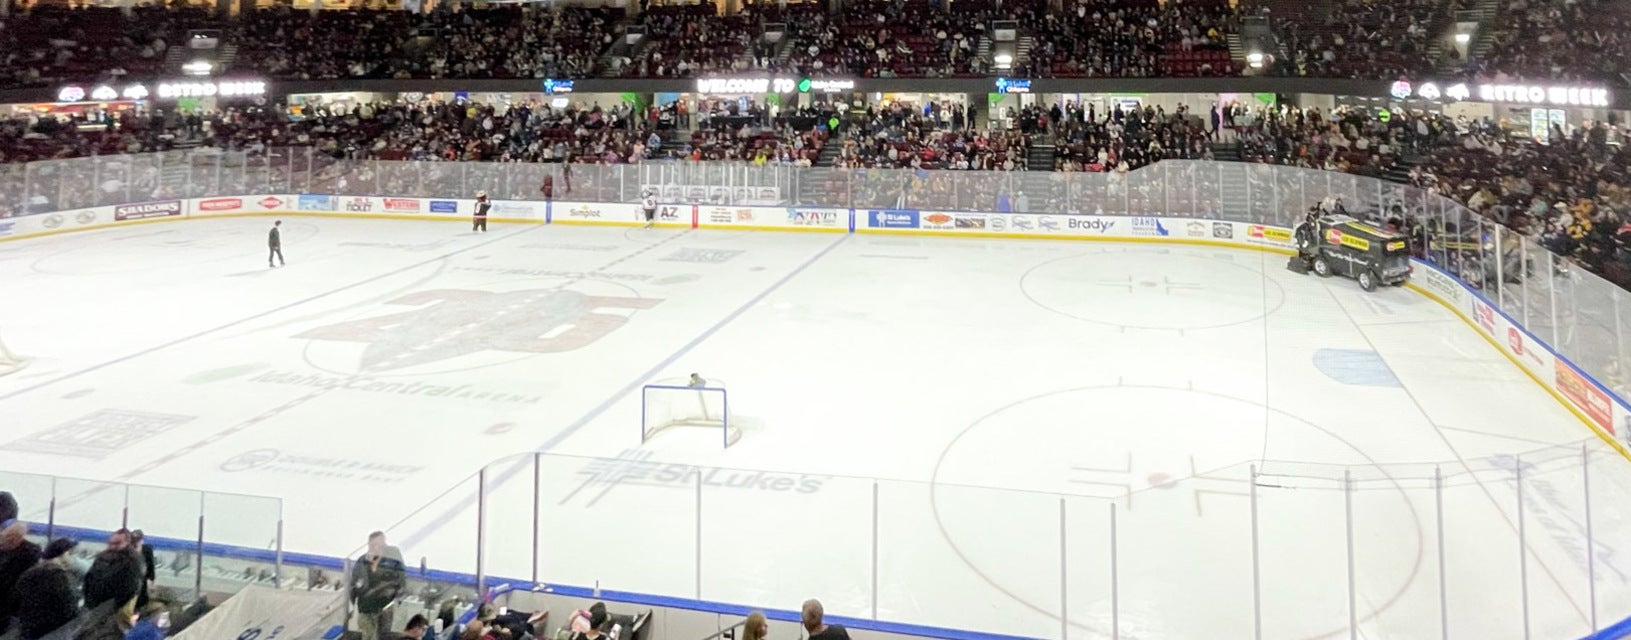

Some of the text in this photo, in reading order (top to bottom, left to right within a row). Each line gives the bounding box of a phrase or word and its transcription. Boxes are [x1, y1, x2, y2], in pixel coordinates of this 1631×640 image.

[158, 81, 266, 97] RETRO WEEK
[697, 78, 795, 93] WELCOME TO
[1480, 84, 1609, 105] RETRO WEEK
[570, 209, 600, 217] Simplot
[661, 207, 679, 217] AZ
[1069, 218, 1107, 233] Brady
[1131, 217, 1155, 226] IDAHO
[248, 370, 338, 388] Idaho
[341, 375, 472, 396] Central
[702, 466, 823, 494] Luke's
